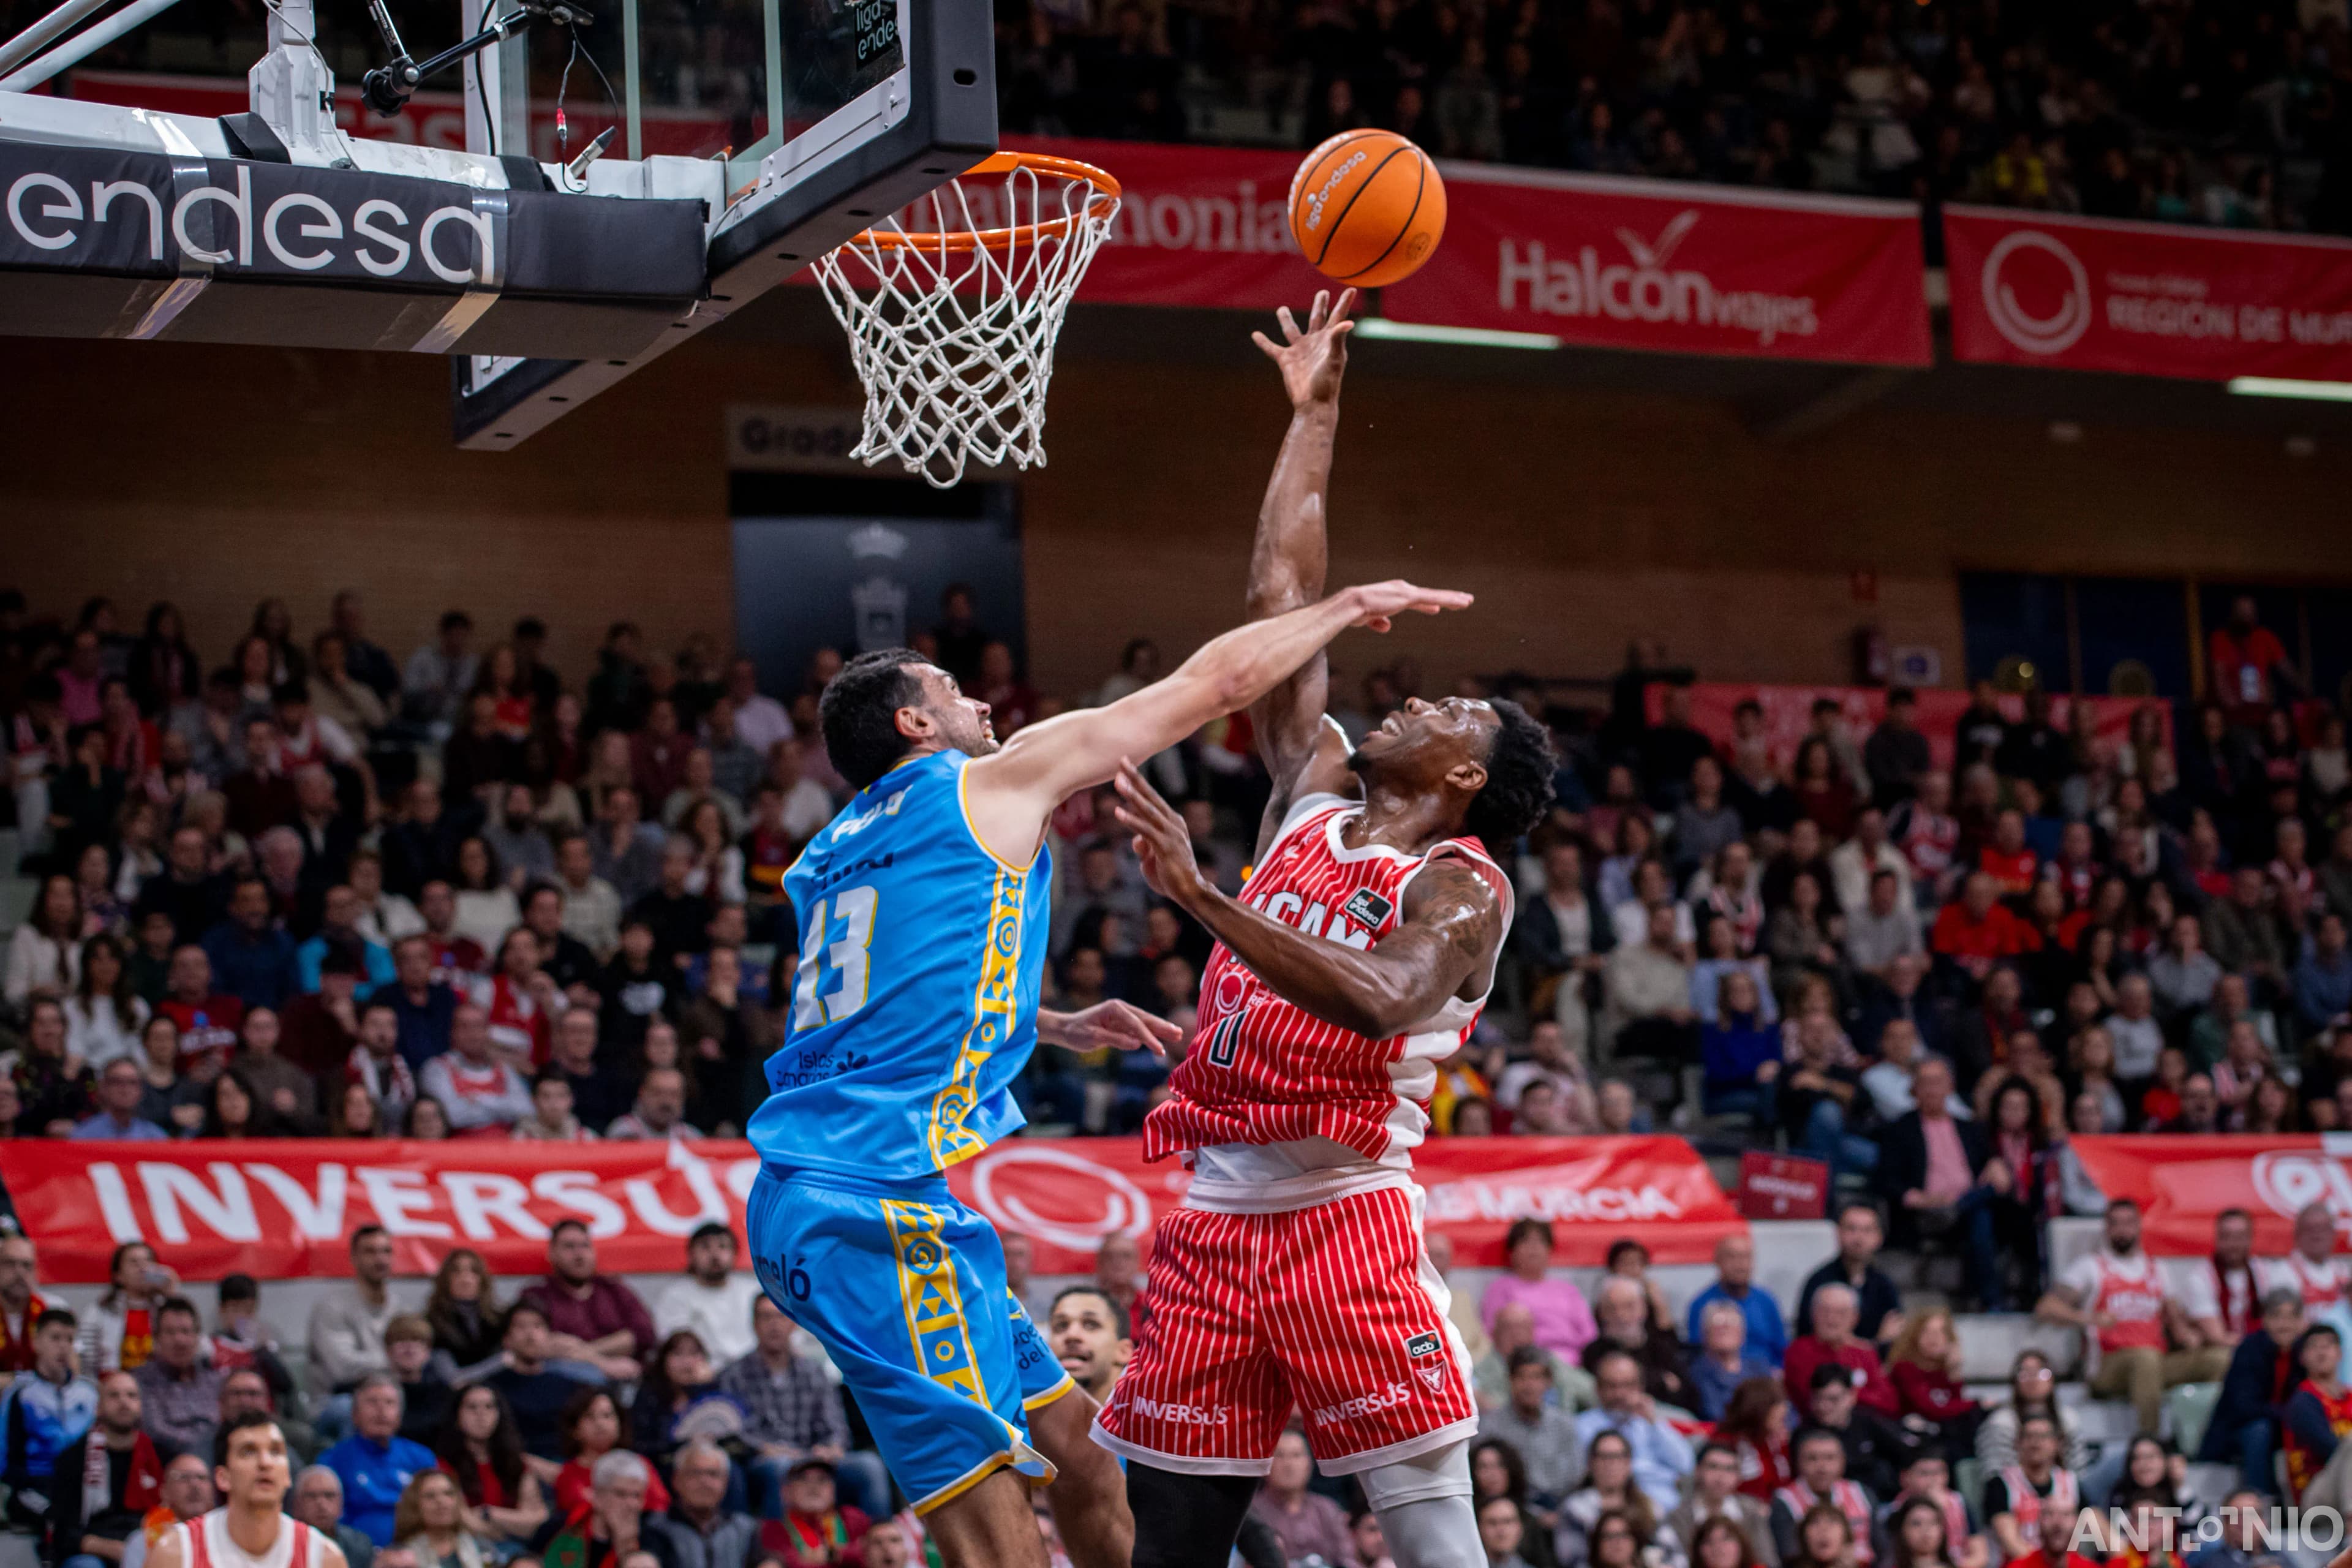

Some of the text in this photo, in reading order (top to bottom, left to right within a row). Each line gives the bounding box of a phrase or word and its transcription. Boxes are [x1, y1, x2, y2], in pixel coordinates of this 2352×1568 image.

[856, 0, 881, 32] liga
[7, 165, 494, 284] endesa
[794, 885, 878, 1031] 13
[1412, 1340, 1435, 1355] acb
[1135, 1395, 1228, 1425] INVERSUS
[1314, 1381, 1411, 1426] INVERSUS
